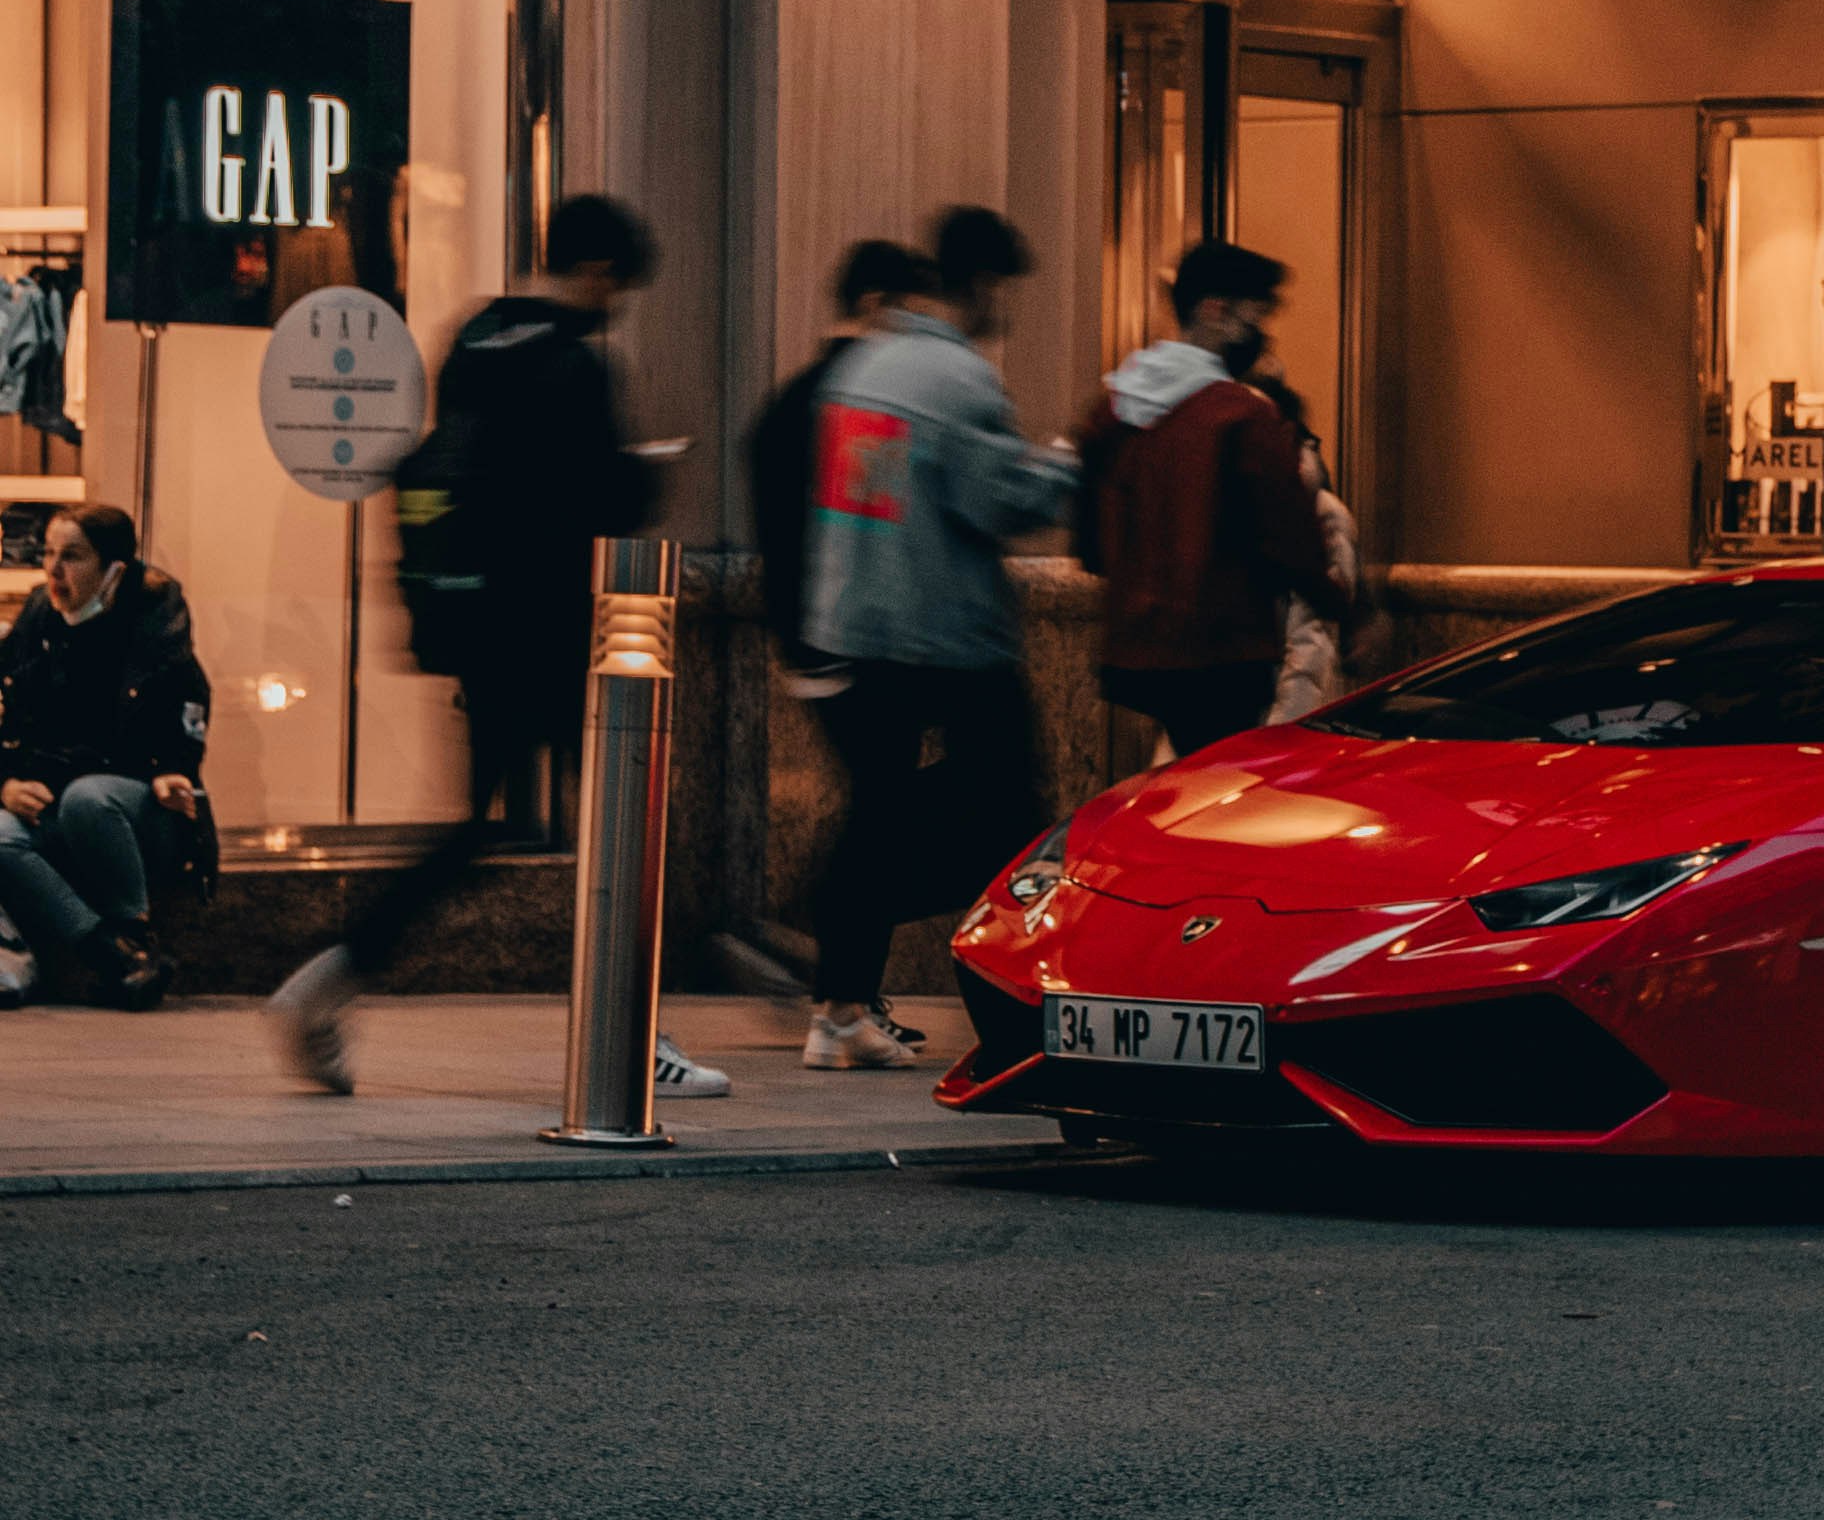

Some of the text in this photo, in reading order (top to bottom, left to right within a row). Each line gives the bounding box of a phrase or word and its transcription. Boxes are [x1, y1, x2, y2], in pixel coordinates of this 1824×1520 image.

[202, 84, 351, 229] GAP
[1061, 1004, 1095, 1054] 34
[1113, 1007, 1149, 1058] MP
[1171, 1011, 1257, 1064] 7172
